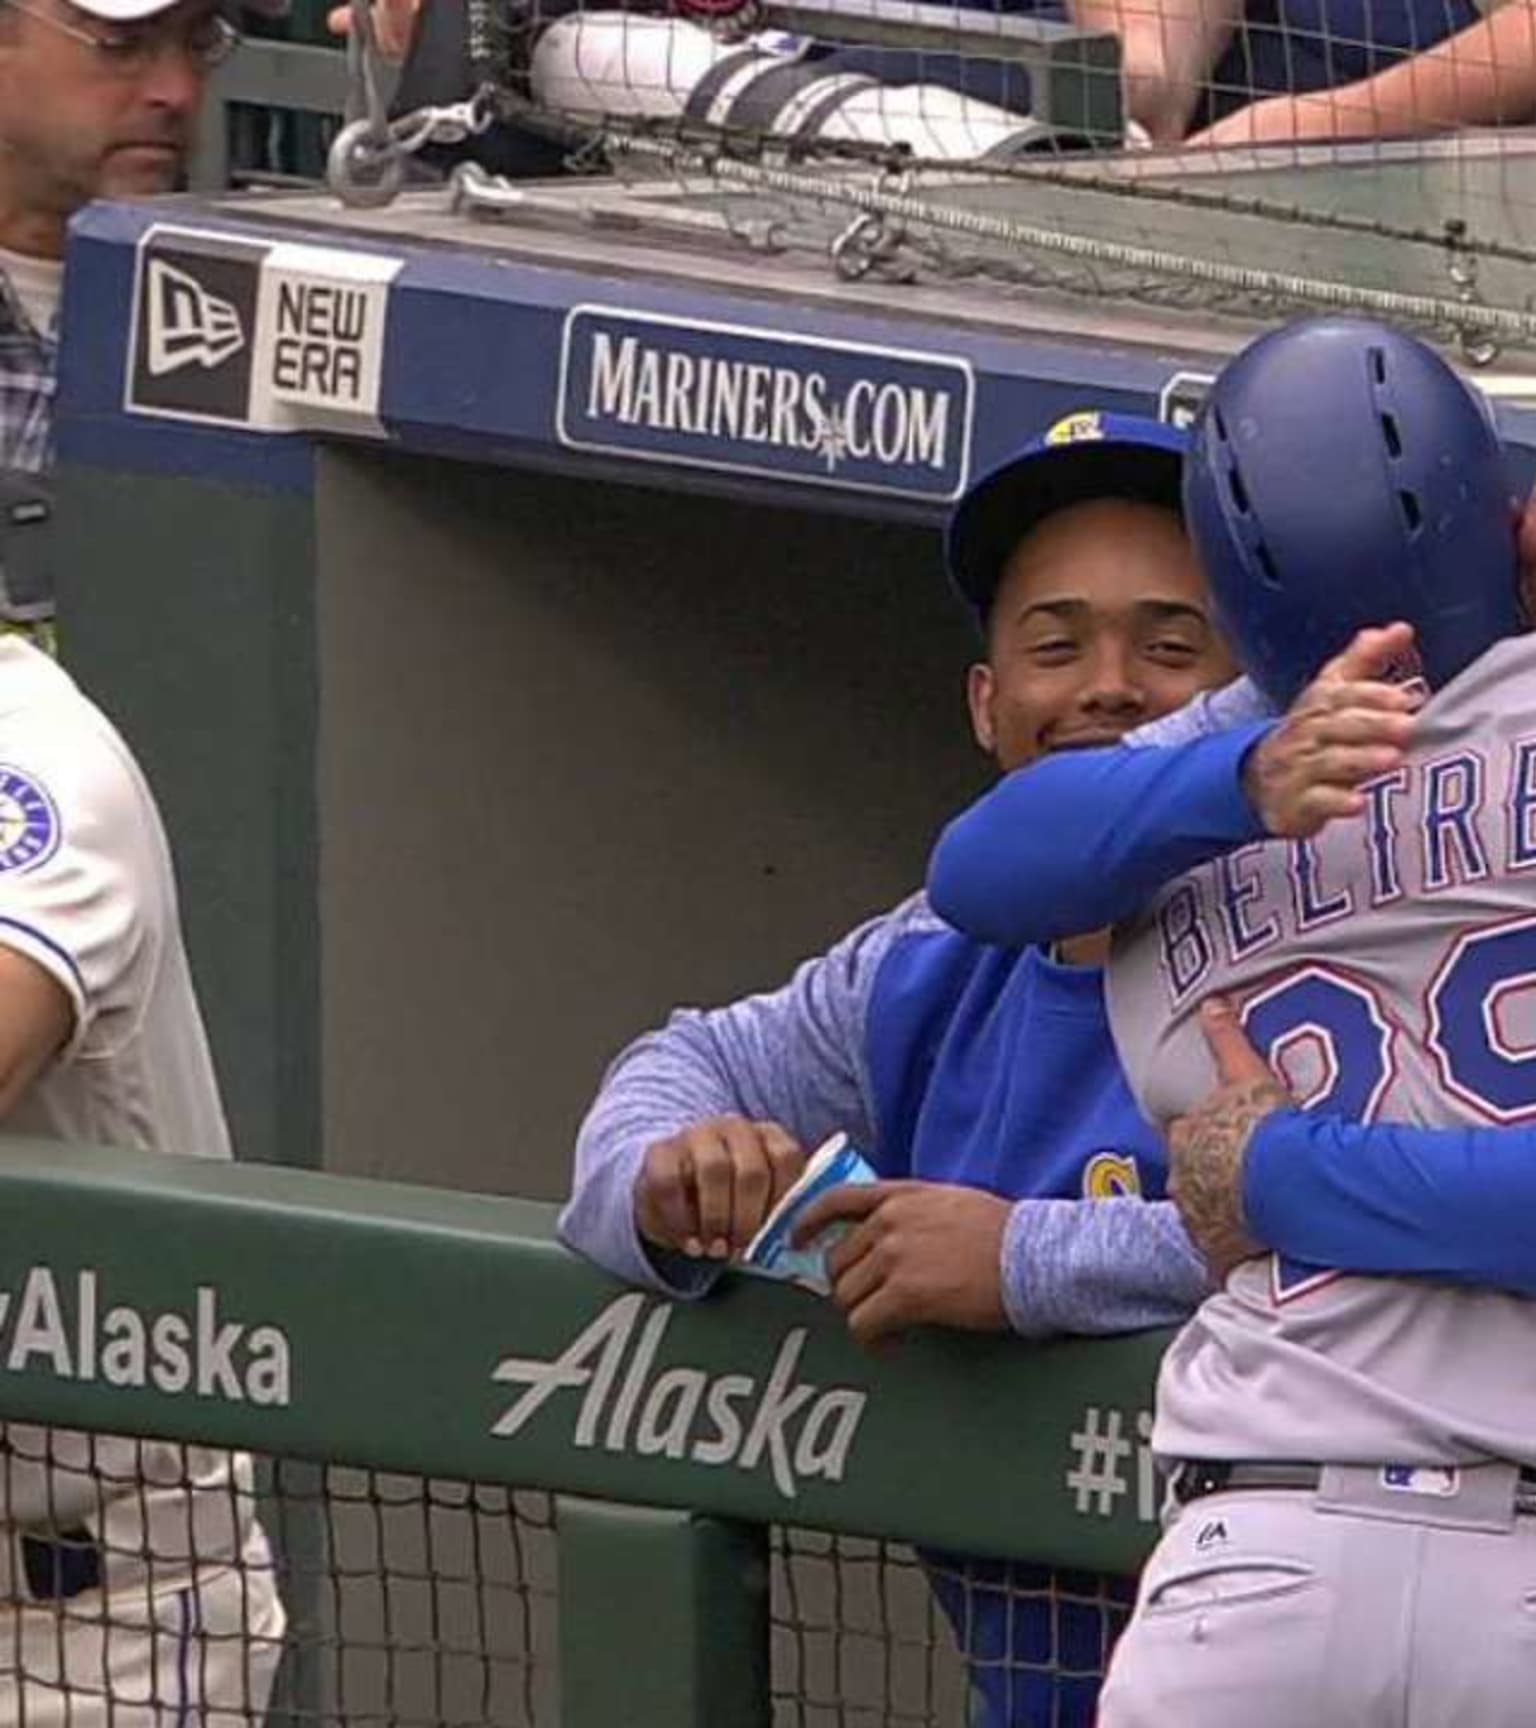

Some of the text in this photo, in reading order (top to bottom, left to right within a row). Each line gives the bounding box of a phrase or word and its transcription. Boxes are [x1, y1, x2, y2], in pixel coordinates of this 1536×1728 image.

[277, 282, 366, 342] NEW
[273, 338, 361, 400] ERA
[0, 1265, 290, 1406] Alaska
[490, 1292, 866, 1498] Alaska
